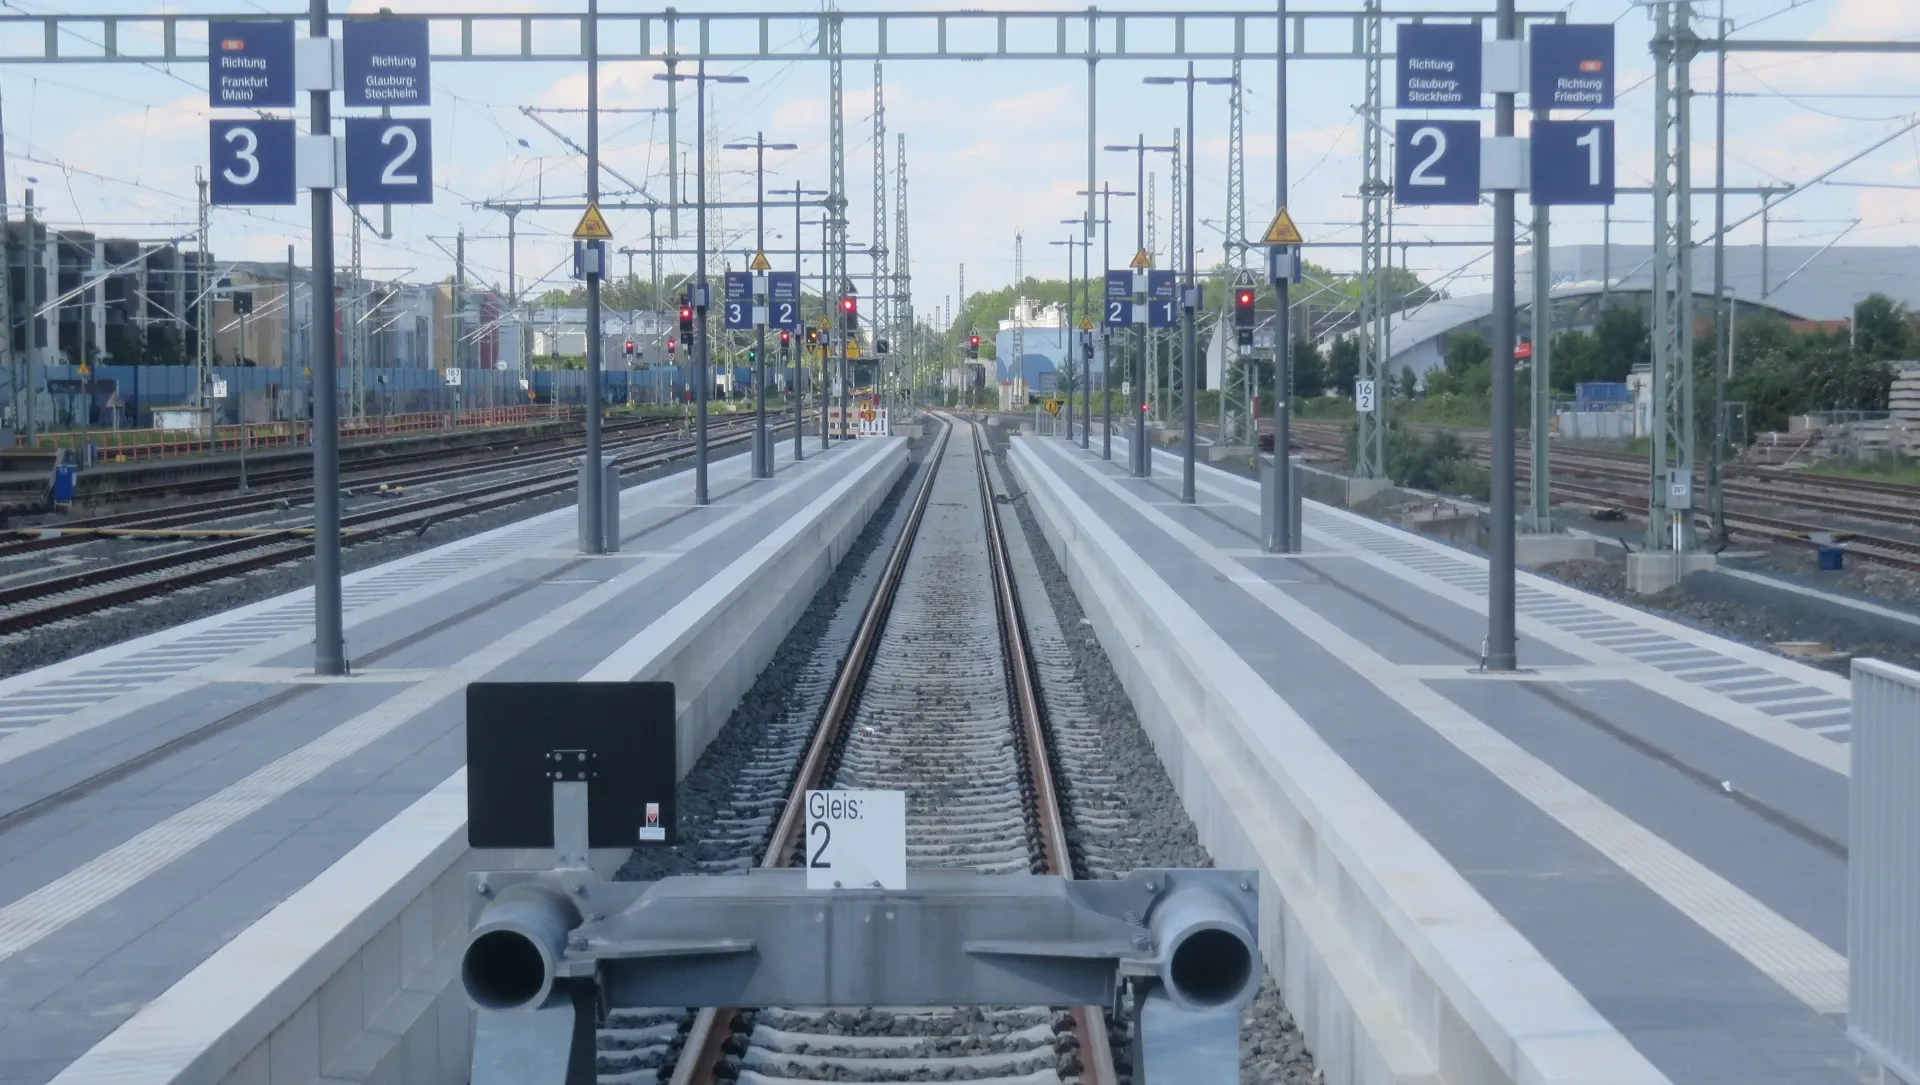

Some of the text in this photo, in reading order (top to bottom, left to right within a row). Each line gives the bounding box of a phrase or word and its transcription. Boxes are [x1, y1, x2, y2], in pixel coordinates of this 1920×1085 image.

[221, 57, 267, 70] Richtung
[372, 56, 417, 69] Richtung
[1409, 59, 1454, 72] Richtung
[222, 76, 268, 88] Frankfurt
[366, 75, 417, 89] Glauburg-
[1408, 78, 1460, 91] Glauburg-
[1557, 78, 1603, 91] Richtung
[222, 89, 254, 101] (Main)
[365, 88, 418, 99] Stockheim
[1408, 91, 1461, 102] Stockheim
[1554, 91, 1603, 104] Friedberg
[223, 127, 260, 185] 3
[381, 126, 418, 185] 2
[1409, 127, 1447, 186] 2
[1576, 128, 1600, 186] 1
[729, 303, 742, 323] 3
[779, 303, 793, 323] 2
[1109, 302, 1122, 322] 2
[1162, 303, 1172, 322] 1
[1358, 383, 1372, 395] 16
[1361, 396, 1369, 408] 2
[809, 791, 864, 820] Gleis:
[810, 820, 832, 869] 2
